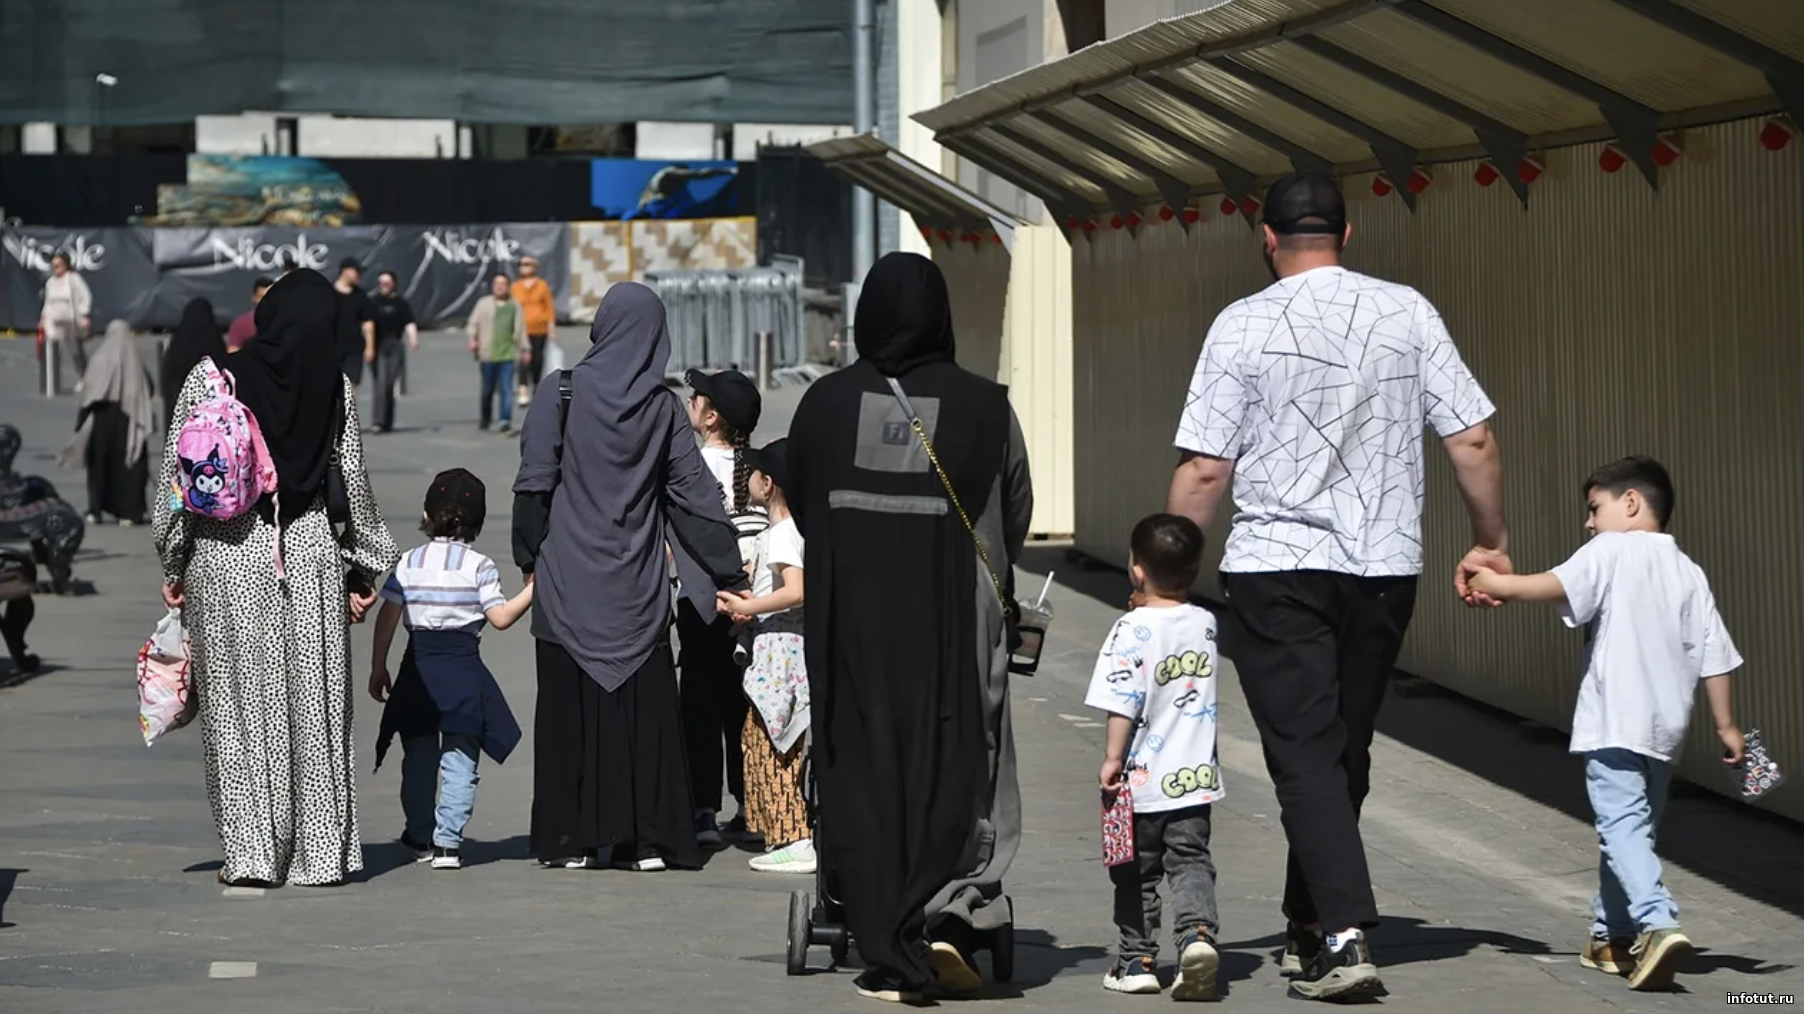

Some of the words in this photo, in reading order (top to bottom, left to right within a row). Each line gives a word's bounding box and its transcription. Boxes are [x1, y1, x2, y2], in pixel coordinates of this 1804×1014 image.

[213, 233, 329, 271] Nicole
[422, 227, 520, 264] Nicole
[1154, 650, 1213, 687] COOL
